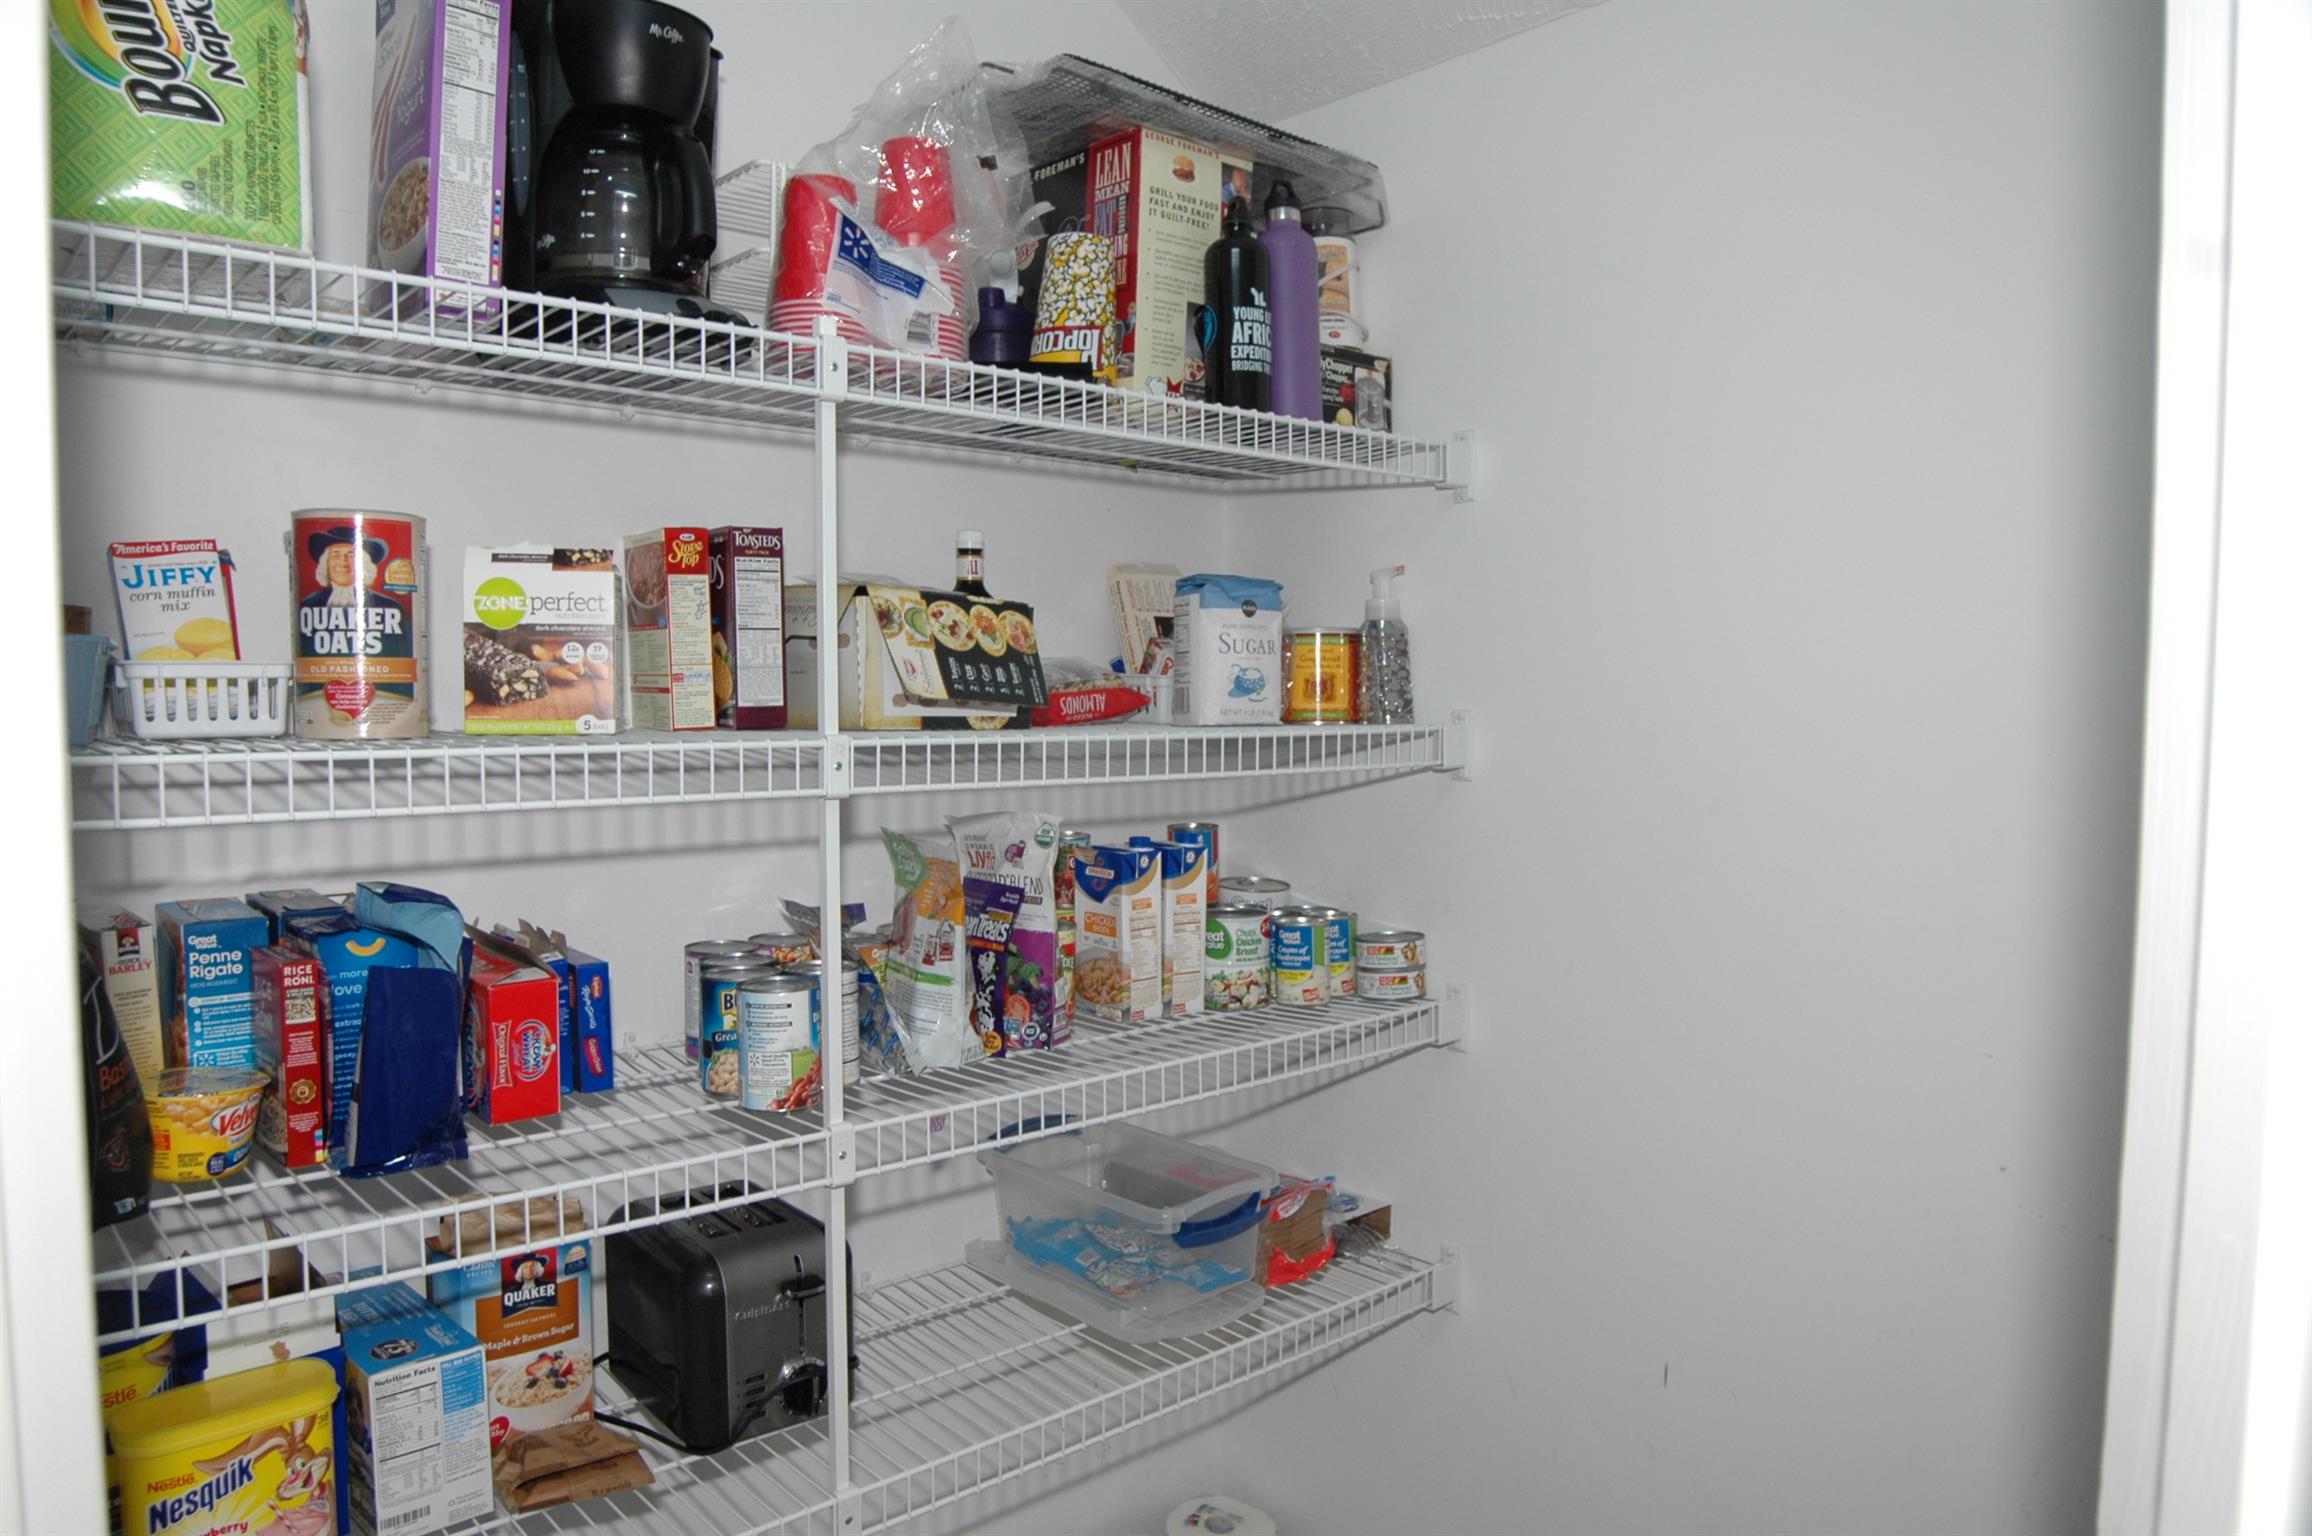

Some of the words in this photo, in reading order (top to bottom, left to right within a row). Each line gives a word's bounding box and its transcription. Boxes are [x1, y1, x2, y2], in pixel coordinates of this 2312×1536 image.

[1145, 131, 1175, 146] GEORGE
[1034, 152, 1085, 181] FOREMAN'S
[1095, 142, 1132, 189] LEAN
[1095, 180, 1130, 202] MEAN
[1149, 186, 1173, 199] GRILL
[1176, 193, 1197, 205] YOUR
[1199, 199, 1219, 212] FOOD
[1094, 199, 1117, 236] FAT
[1148, 207, 1157, 216] IT
[1149, 196, 1169, 209] FAST
[1172, 202, 1188, 214] AND
[1191, 208, 1215, 221] ENJOY
[1233, 306, 1264, 320] YOUNG
[112, 543, 169, 555] America's
[171, 541, 213, 553] Favorite
[733, 530, 781, 550] TOASTEDS
[668, 540, 704, 563] Stove
[682, 553, 699, 569] Top
[121, 564, 215, 589] JIFFY
[129, 590, 163, 602] corn
[167, 586, 215, 600] muffin
[475, 595, 528, 612] ZONE
[530, 591, 606, 615] perfect
[161, 600, 190, 612] mix
[300, 607, 402, 637] QUAKER
[314, 631, 382, 655] OATS
[1219, 632, 1277, 654] SUGAR
[1060, 693, 1106, 715] ALMONDS
[583, 720, 592, 731] 5
[188, 934, 217, 945] Great
[108, 961, 152, 976] BARLEY
[189, 951, 242, 965] Penne
[190, 962, 243, 980] Rigate
[284, 965, 312, 976] RICE
[340, 969, 368, 979] more
[332, 984, 363, 996] ove
[496, 1025, 508, 1058] Original
[498, 1058, 508, 1085] Flavor
[504, 1283, 556, 1306] QUAKER
[485, 1334, 513, 1351] Maple
[523, 1330, 550, 1343] Brown
[551, 1322, 575, 1336] Sugar
[374, 1373, 412, 1387] Nutrition
[414, 1366, 436, 1377] Facts
[149, 1457, 253, 1534] Nesquik
